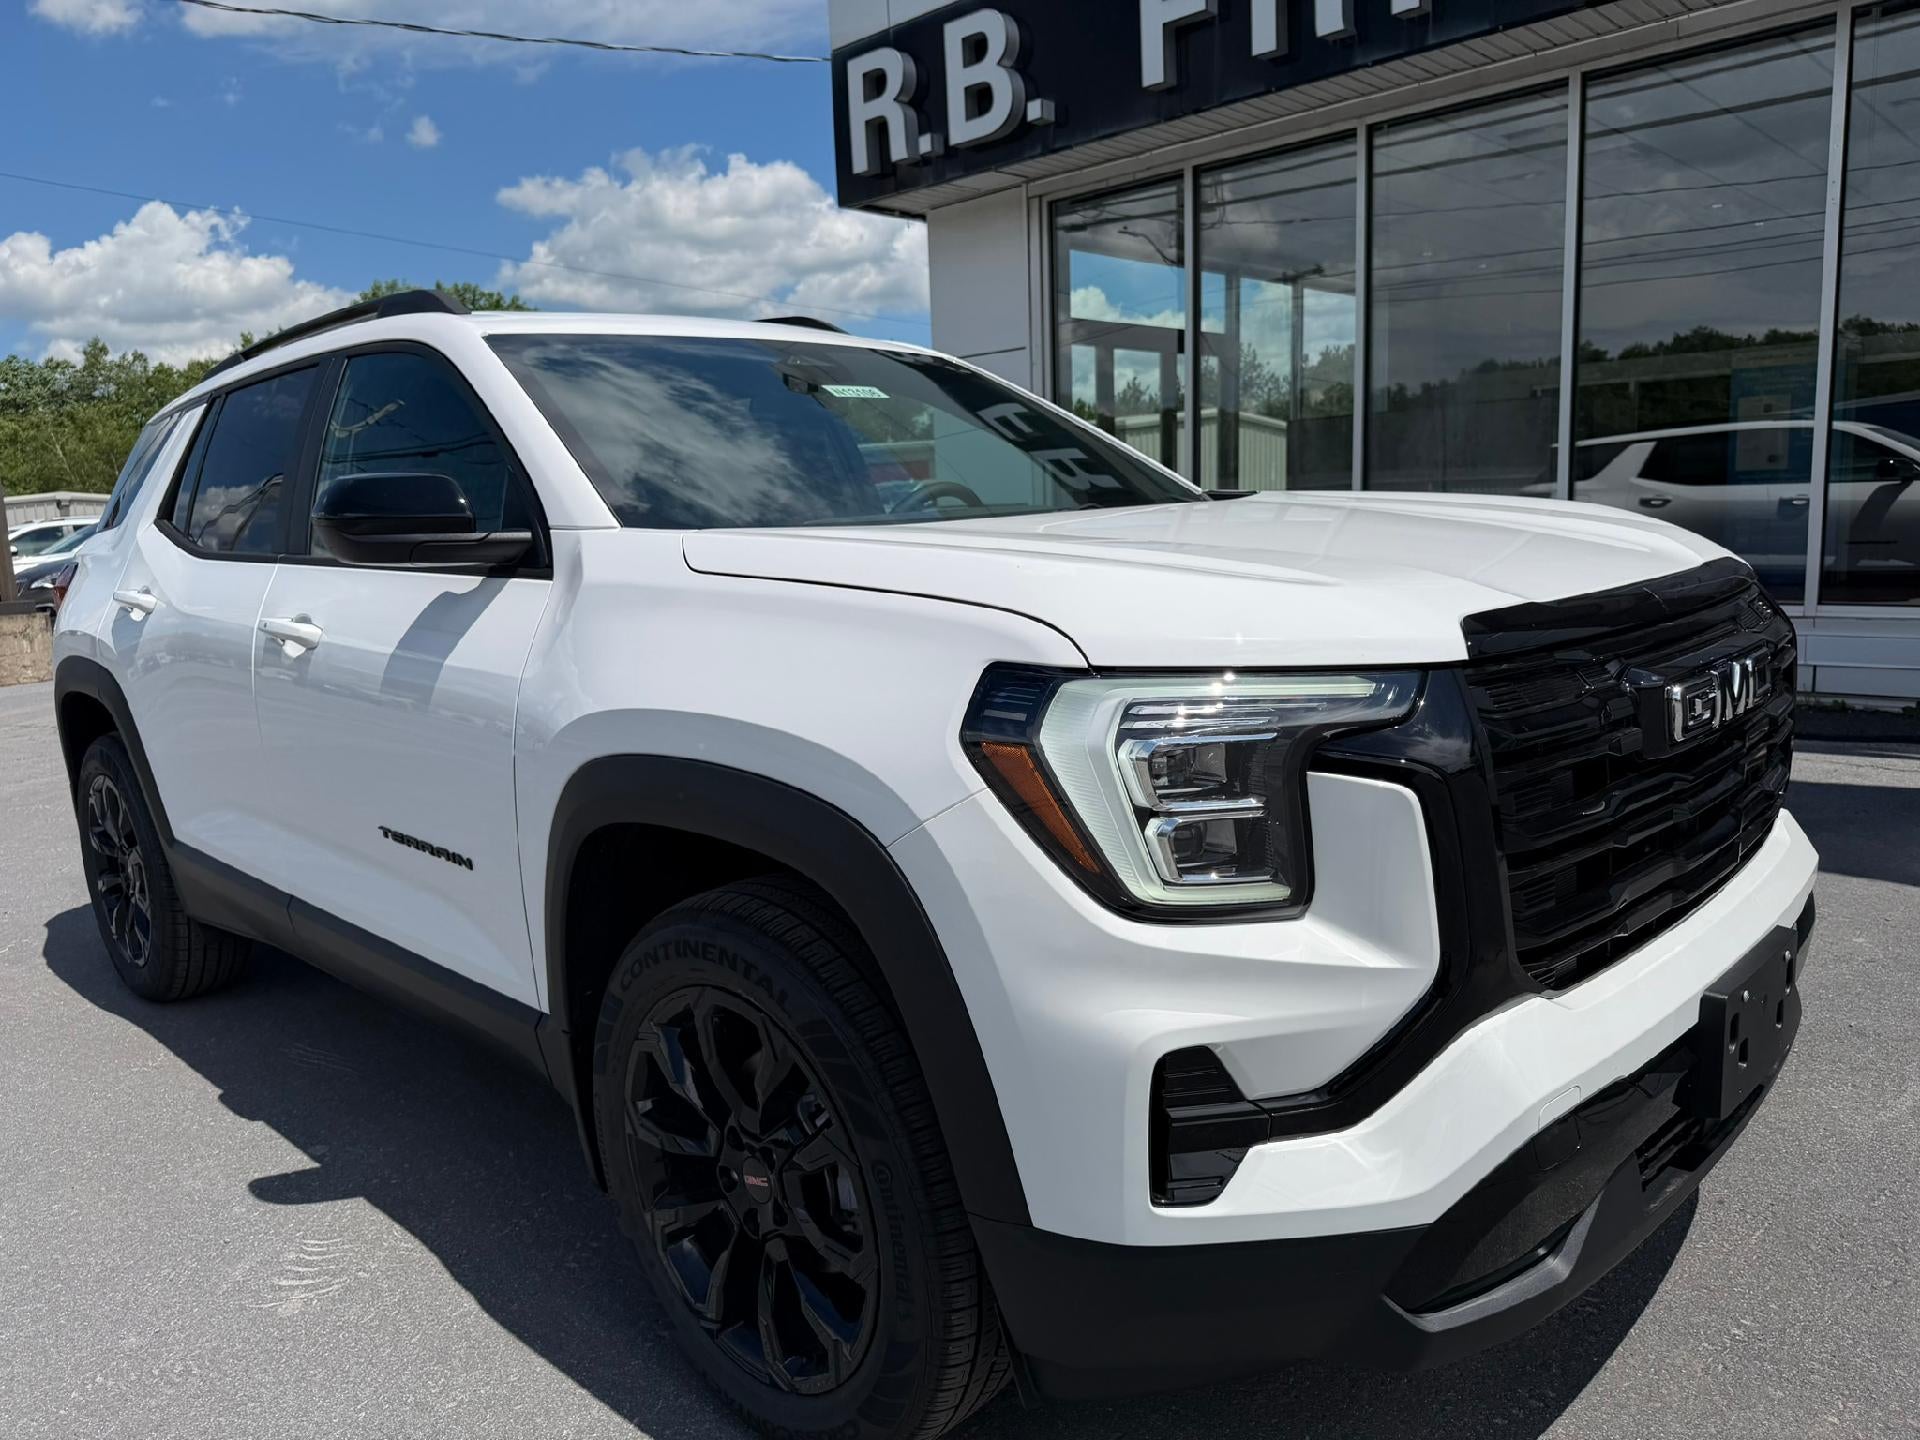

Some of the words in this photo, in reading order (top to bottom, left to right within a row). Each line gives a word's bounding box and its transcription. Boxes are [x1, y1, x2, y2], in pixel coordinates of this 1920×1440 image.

[847, 8, 1052, 176] R.B.
[1665, 648, 1772, 742] GMC
[378, 825, 473, 871] TERRAIN
[617, 937, 791, 1018] CONTINENTAL
